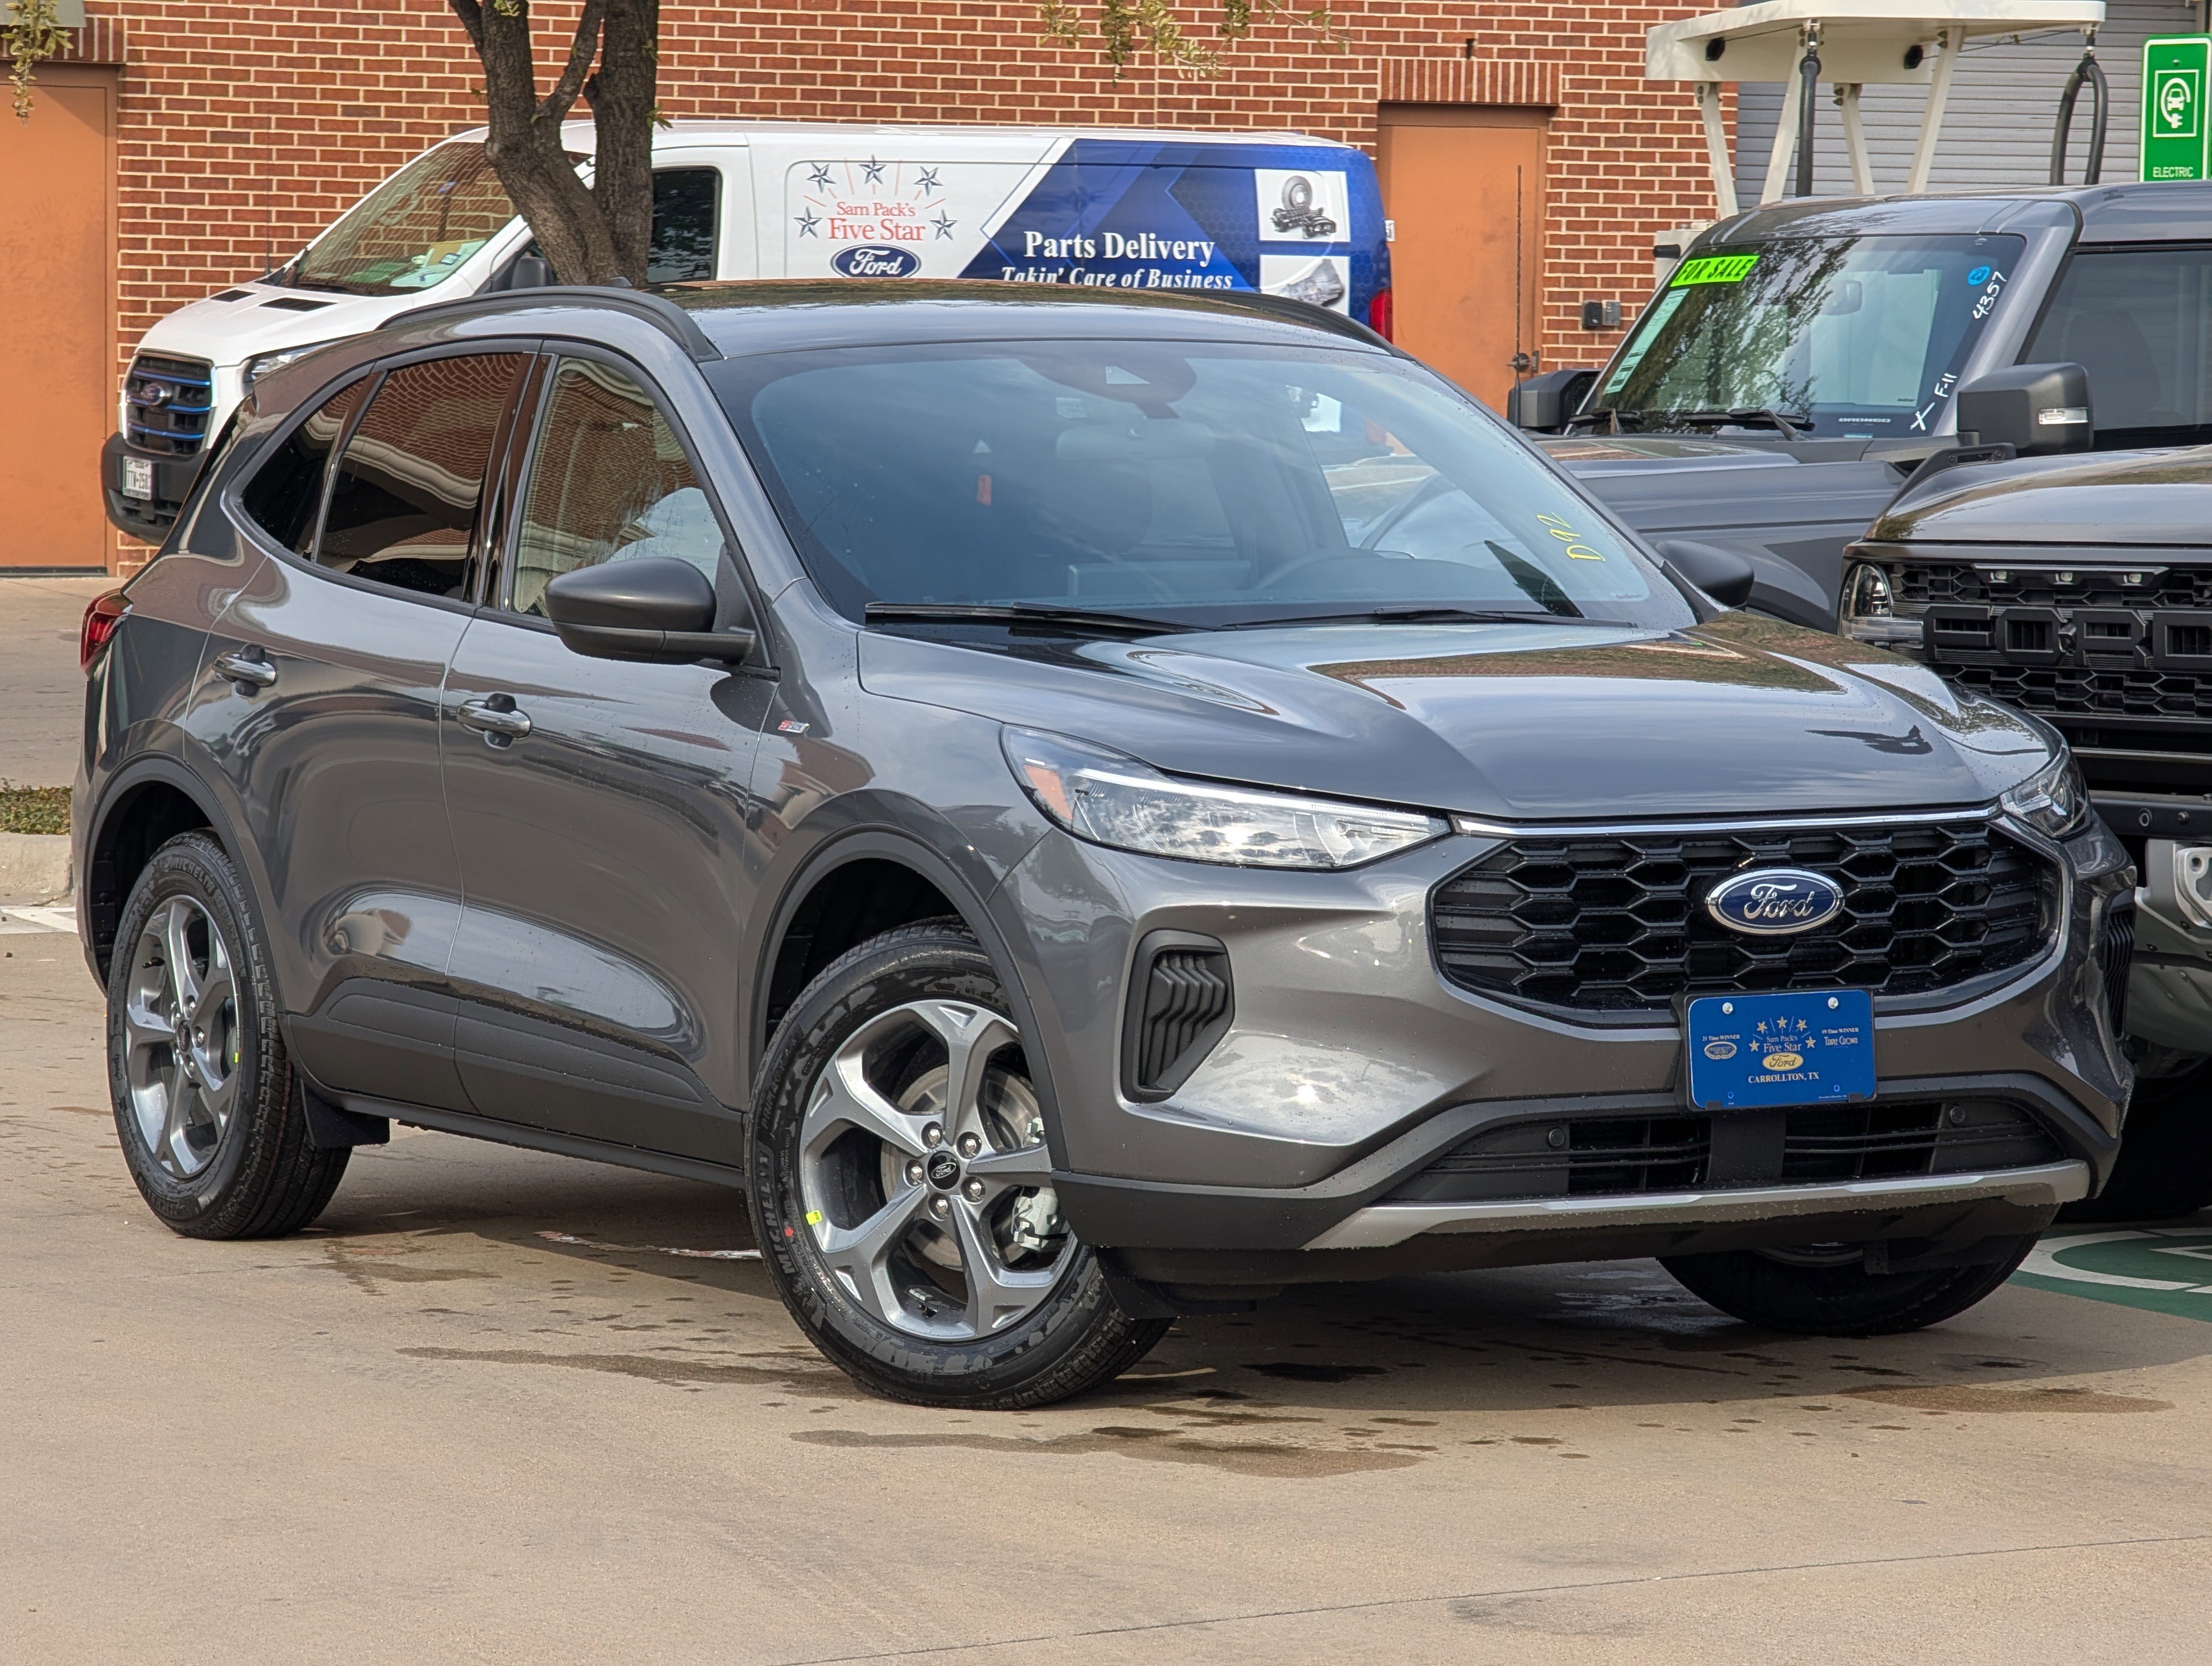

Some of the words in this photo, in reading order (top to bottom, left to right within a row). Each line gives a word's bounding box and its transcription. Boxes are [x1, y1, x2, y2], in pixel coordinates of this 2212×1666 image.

[2152, 166, 2194, 178] ELECTRIC
[837, 201, 867, 216] Sam
[872, 202, 916, 217] Pack's
[827, 217, 875, 240] Five
[880, 219, 926, 241] Star
[1024, 231, 1096, 259] Parts
[1103, 232, 1215, 267] Delivery
[849, 248, 904, 275] Ford
[1675, 261, 1711, 281] FOR
[1707, 259, 1754, 279] SALE
[1002, 267, 1064, 283] Takin'
[1069, 267, 1117, 287] Care
[1121, 268, 1145, 288] of
[1146, 269, 1233, 289] Business
[1973, 271, 2008, 319] 4357
[1536, 511, 1606, 562] D92
[1744, 883, 1815, 919] Ford
[1764, 1043, 1782, 1053] Five
[1784, 1042, 1802, 1052] Star
[1769, 1054, 1797, 1067] Ford
[1748, 1073, 1806, 1084] CARROLLTON,
[1807, 1072, 1819, 1080] TX
[936, 1165, 951, 1177] Ford
